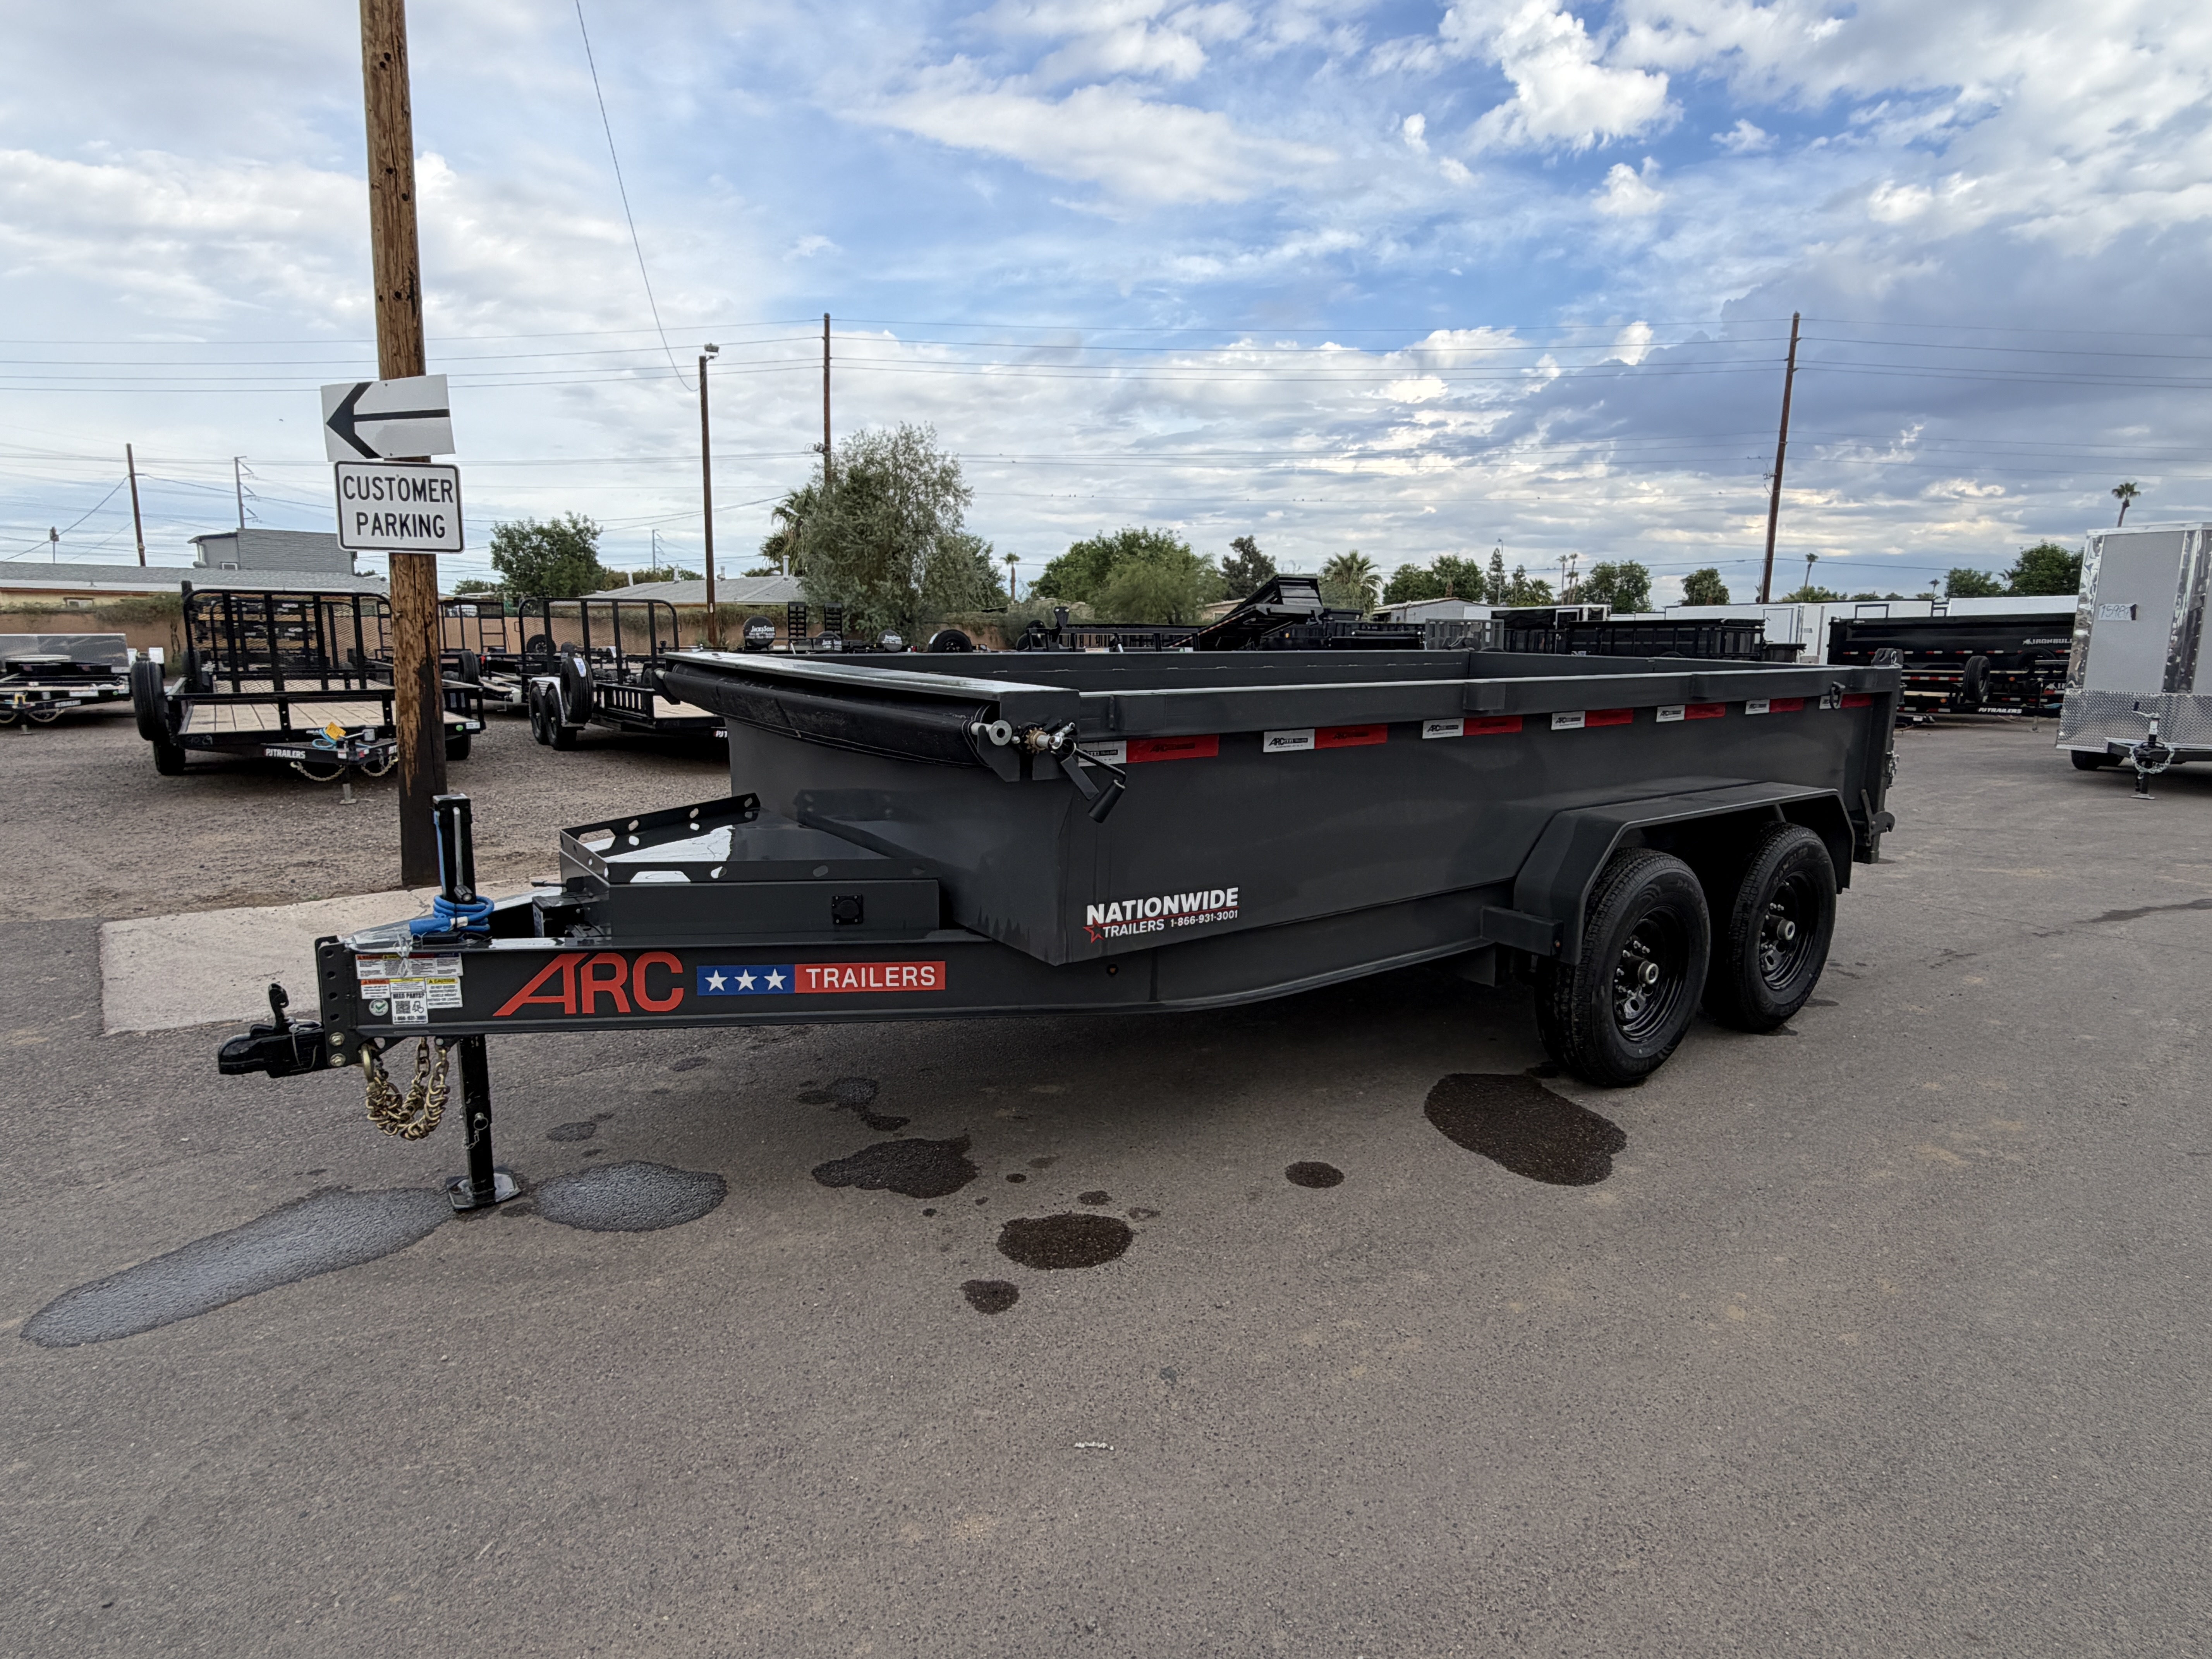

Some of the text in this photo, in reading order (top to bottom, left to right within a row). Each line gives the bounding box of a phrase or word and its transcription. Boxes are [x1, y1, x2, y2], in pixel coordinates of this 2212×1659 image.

[343, 475, 453, 503] CUSTOMER
[356, 512, 445, 539] PARKING
[1268, 737, 1285, 747] ARC
[1086, 887, 1239, 926] NATIONWIDE
[1103, 910, 1238, 938] TRAILERS 1-866-931-3001
[493, 951, 684, 1017] ARC
[806, 966, 936, 988] TRAILERS
